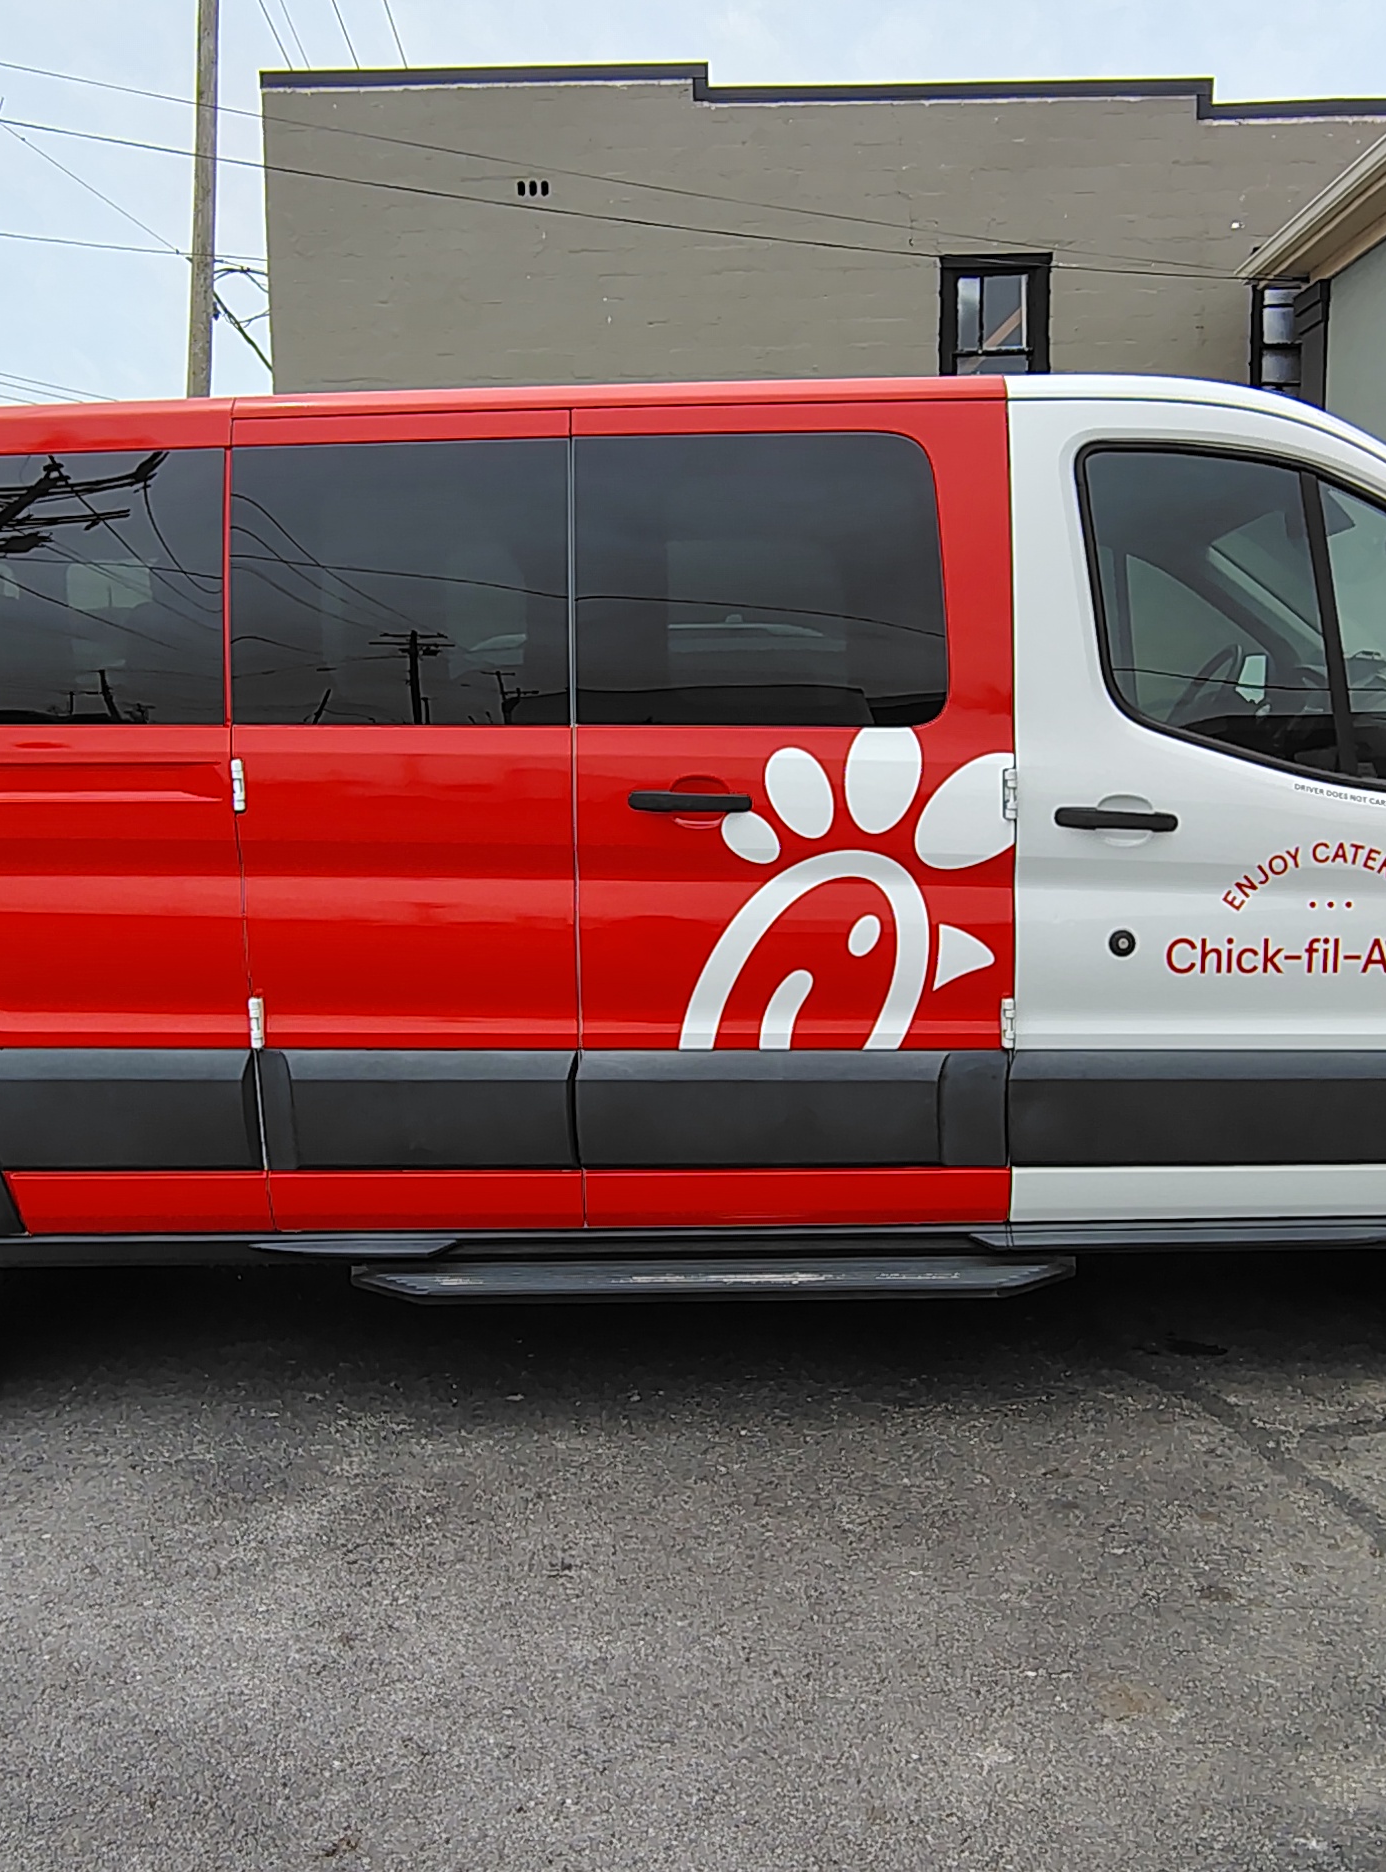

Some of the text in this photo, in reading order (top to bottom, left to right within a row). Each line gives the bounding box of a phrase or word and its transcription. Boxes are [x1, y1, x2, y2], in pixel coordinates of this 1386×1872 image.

[1294, 783, 1324, 796] DRIVER
[1326, 789, 1348, 801] DOES
[1350, 794, 1368, 804] NOT
[1222, 846, 1301, 912] ENJOY
